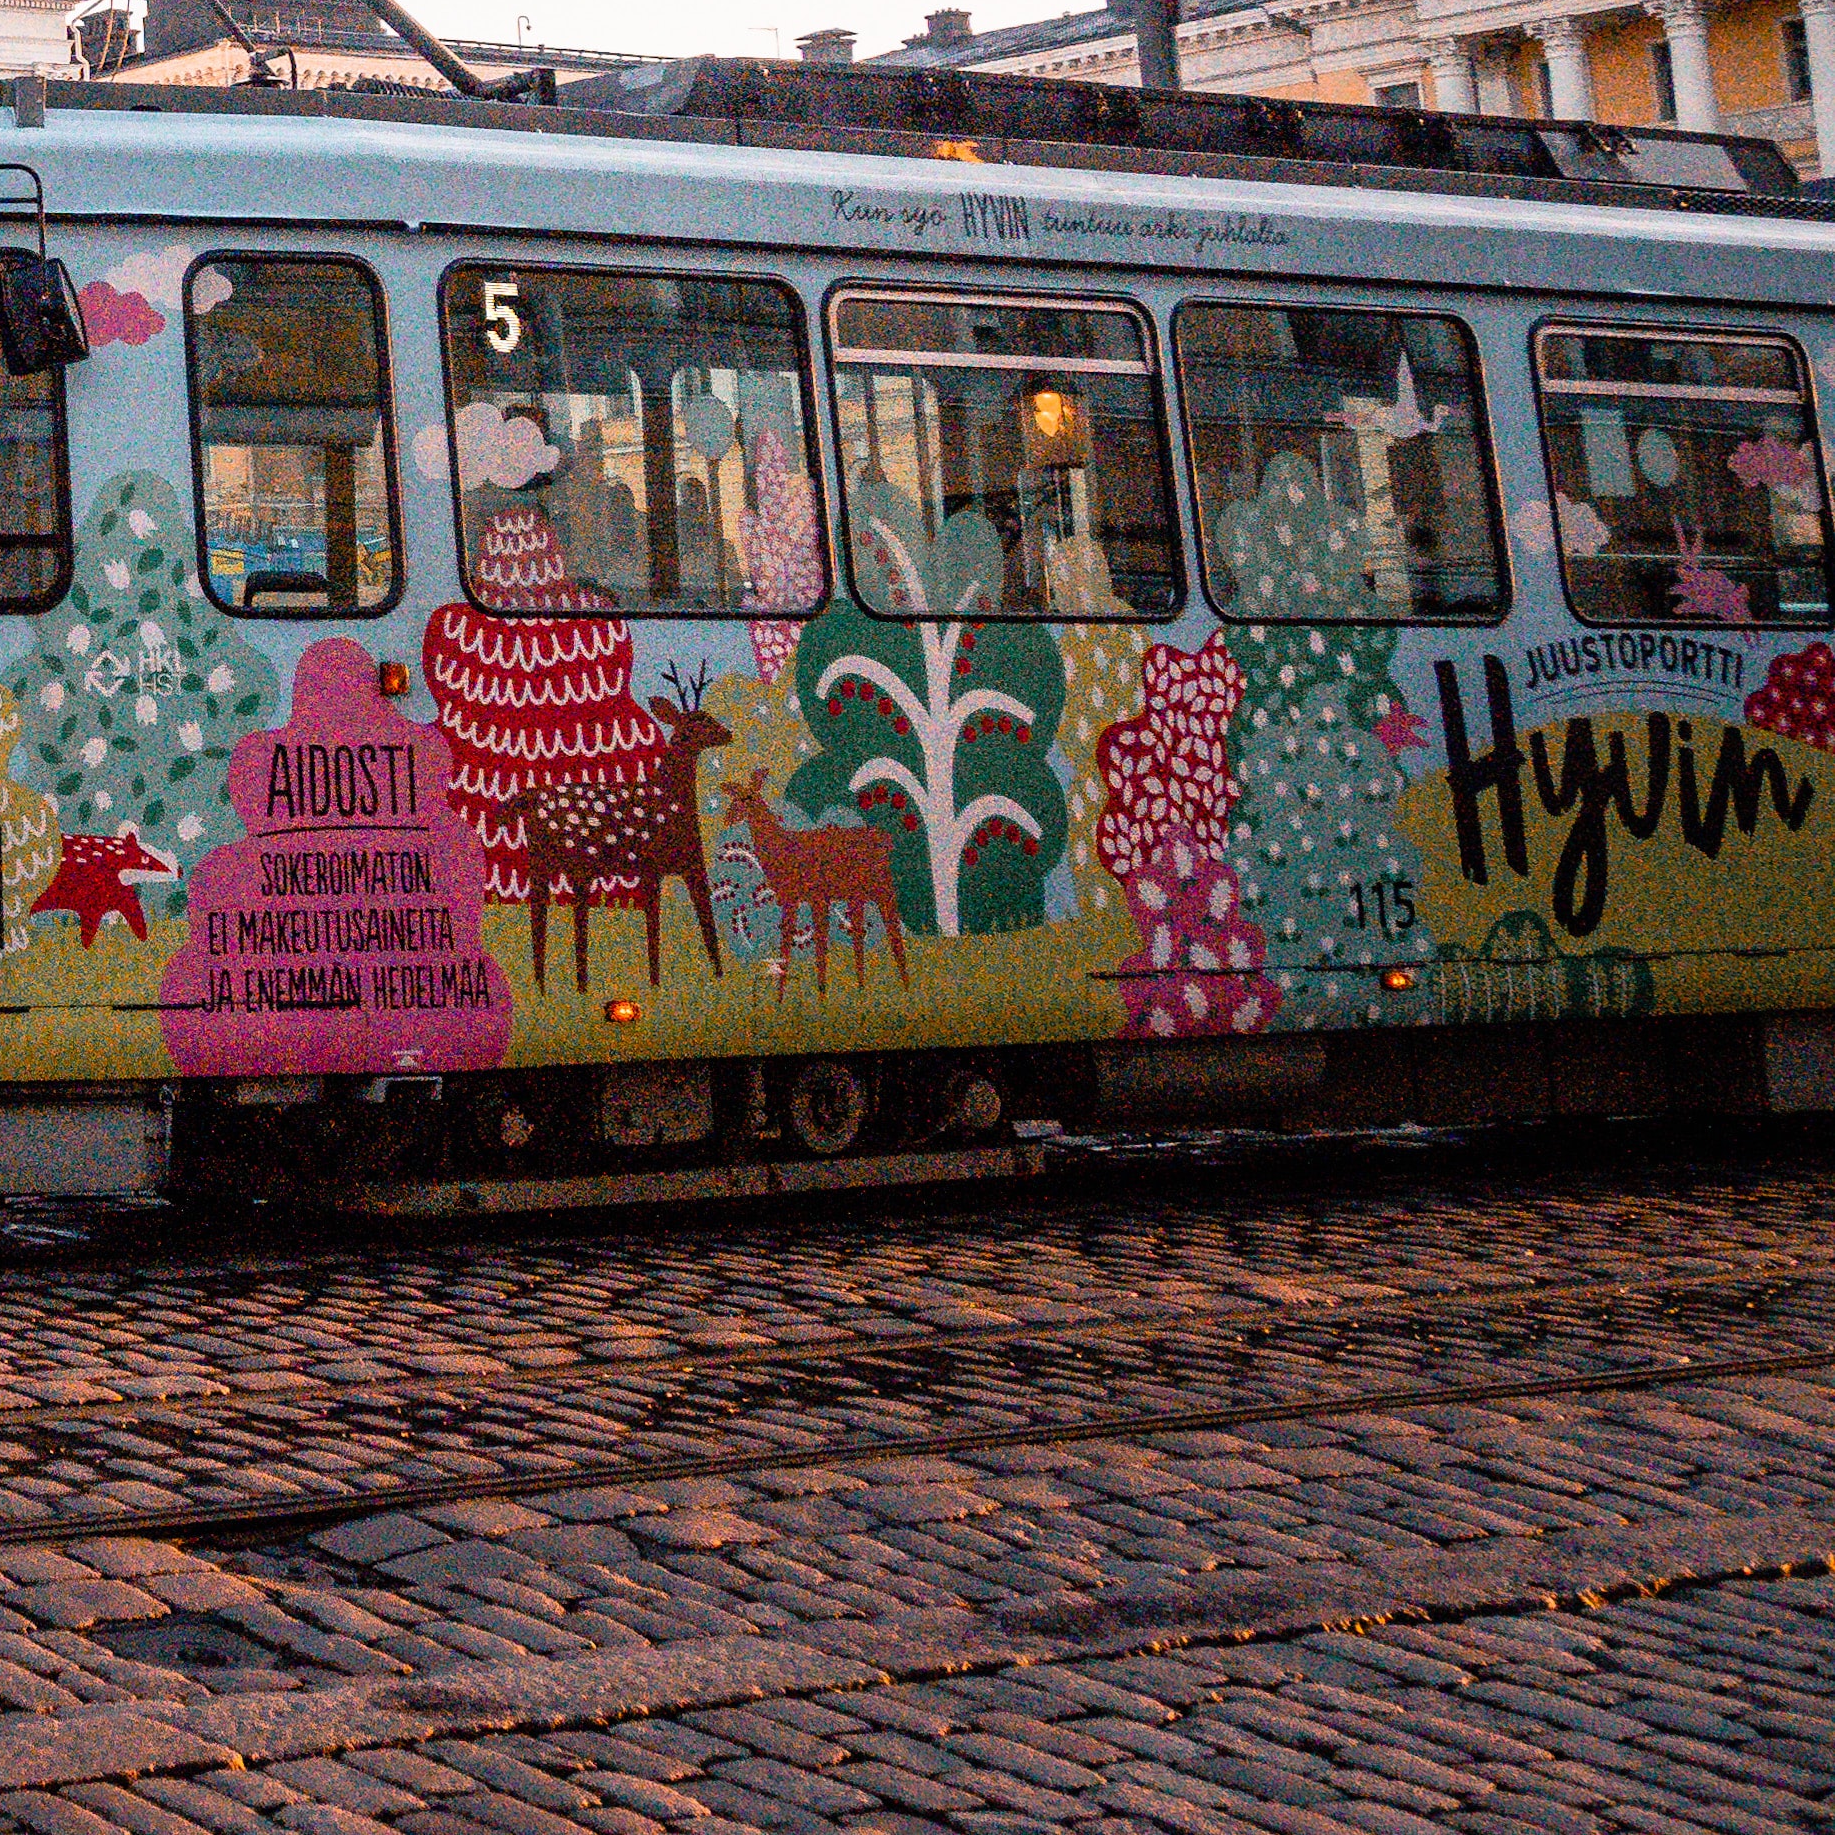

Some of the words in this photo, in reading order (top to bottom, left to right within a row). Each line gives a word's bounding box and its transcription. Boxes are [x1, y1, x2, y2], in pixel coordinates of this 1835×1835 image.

[832, 189, 893, 222] Kun
[960, 191, 1029, 240] HYVIN
[484, 282, 522, 353] 5
[1526, 633, 1743, 689] JUUSTOPORTTI
[266, 743, 417, 818] AIDOSTI
[1434, 654, 1815, 938] Hyvin
[259, 850, 436, 896] SOKEROIMATON.
[208, 911, 228, 955] EI
[238, 907, 455, 955] MAKEUTUSAINEITA
[1350, 881, 1415, 929] 115
[201, 968, 235, 1013] JA
[244, 961, 362, 1013] ENEMMÄN
[372, 958, 492, 1010] HEDELMÄÄ
